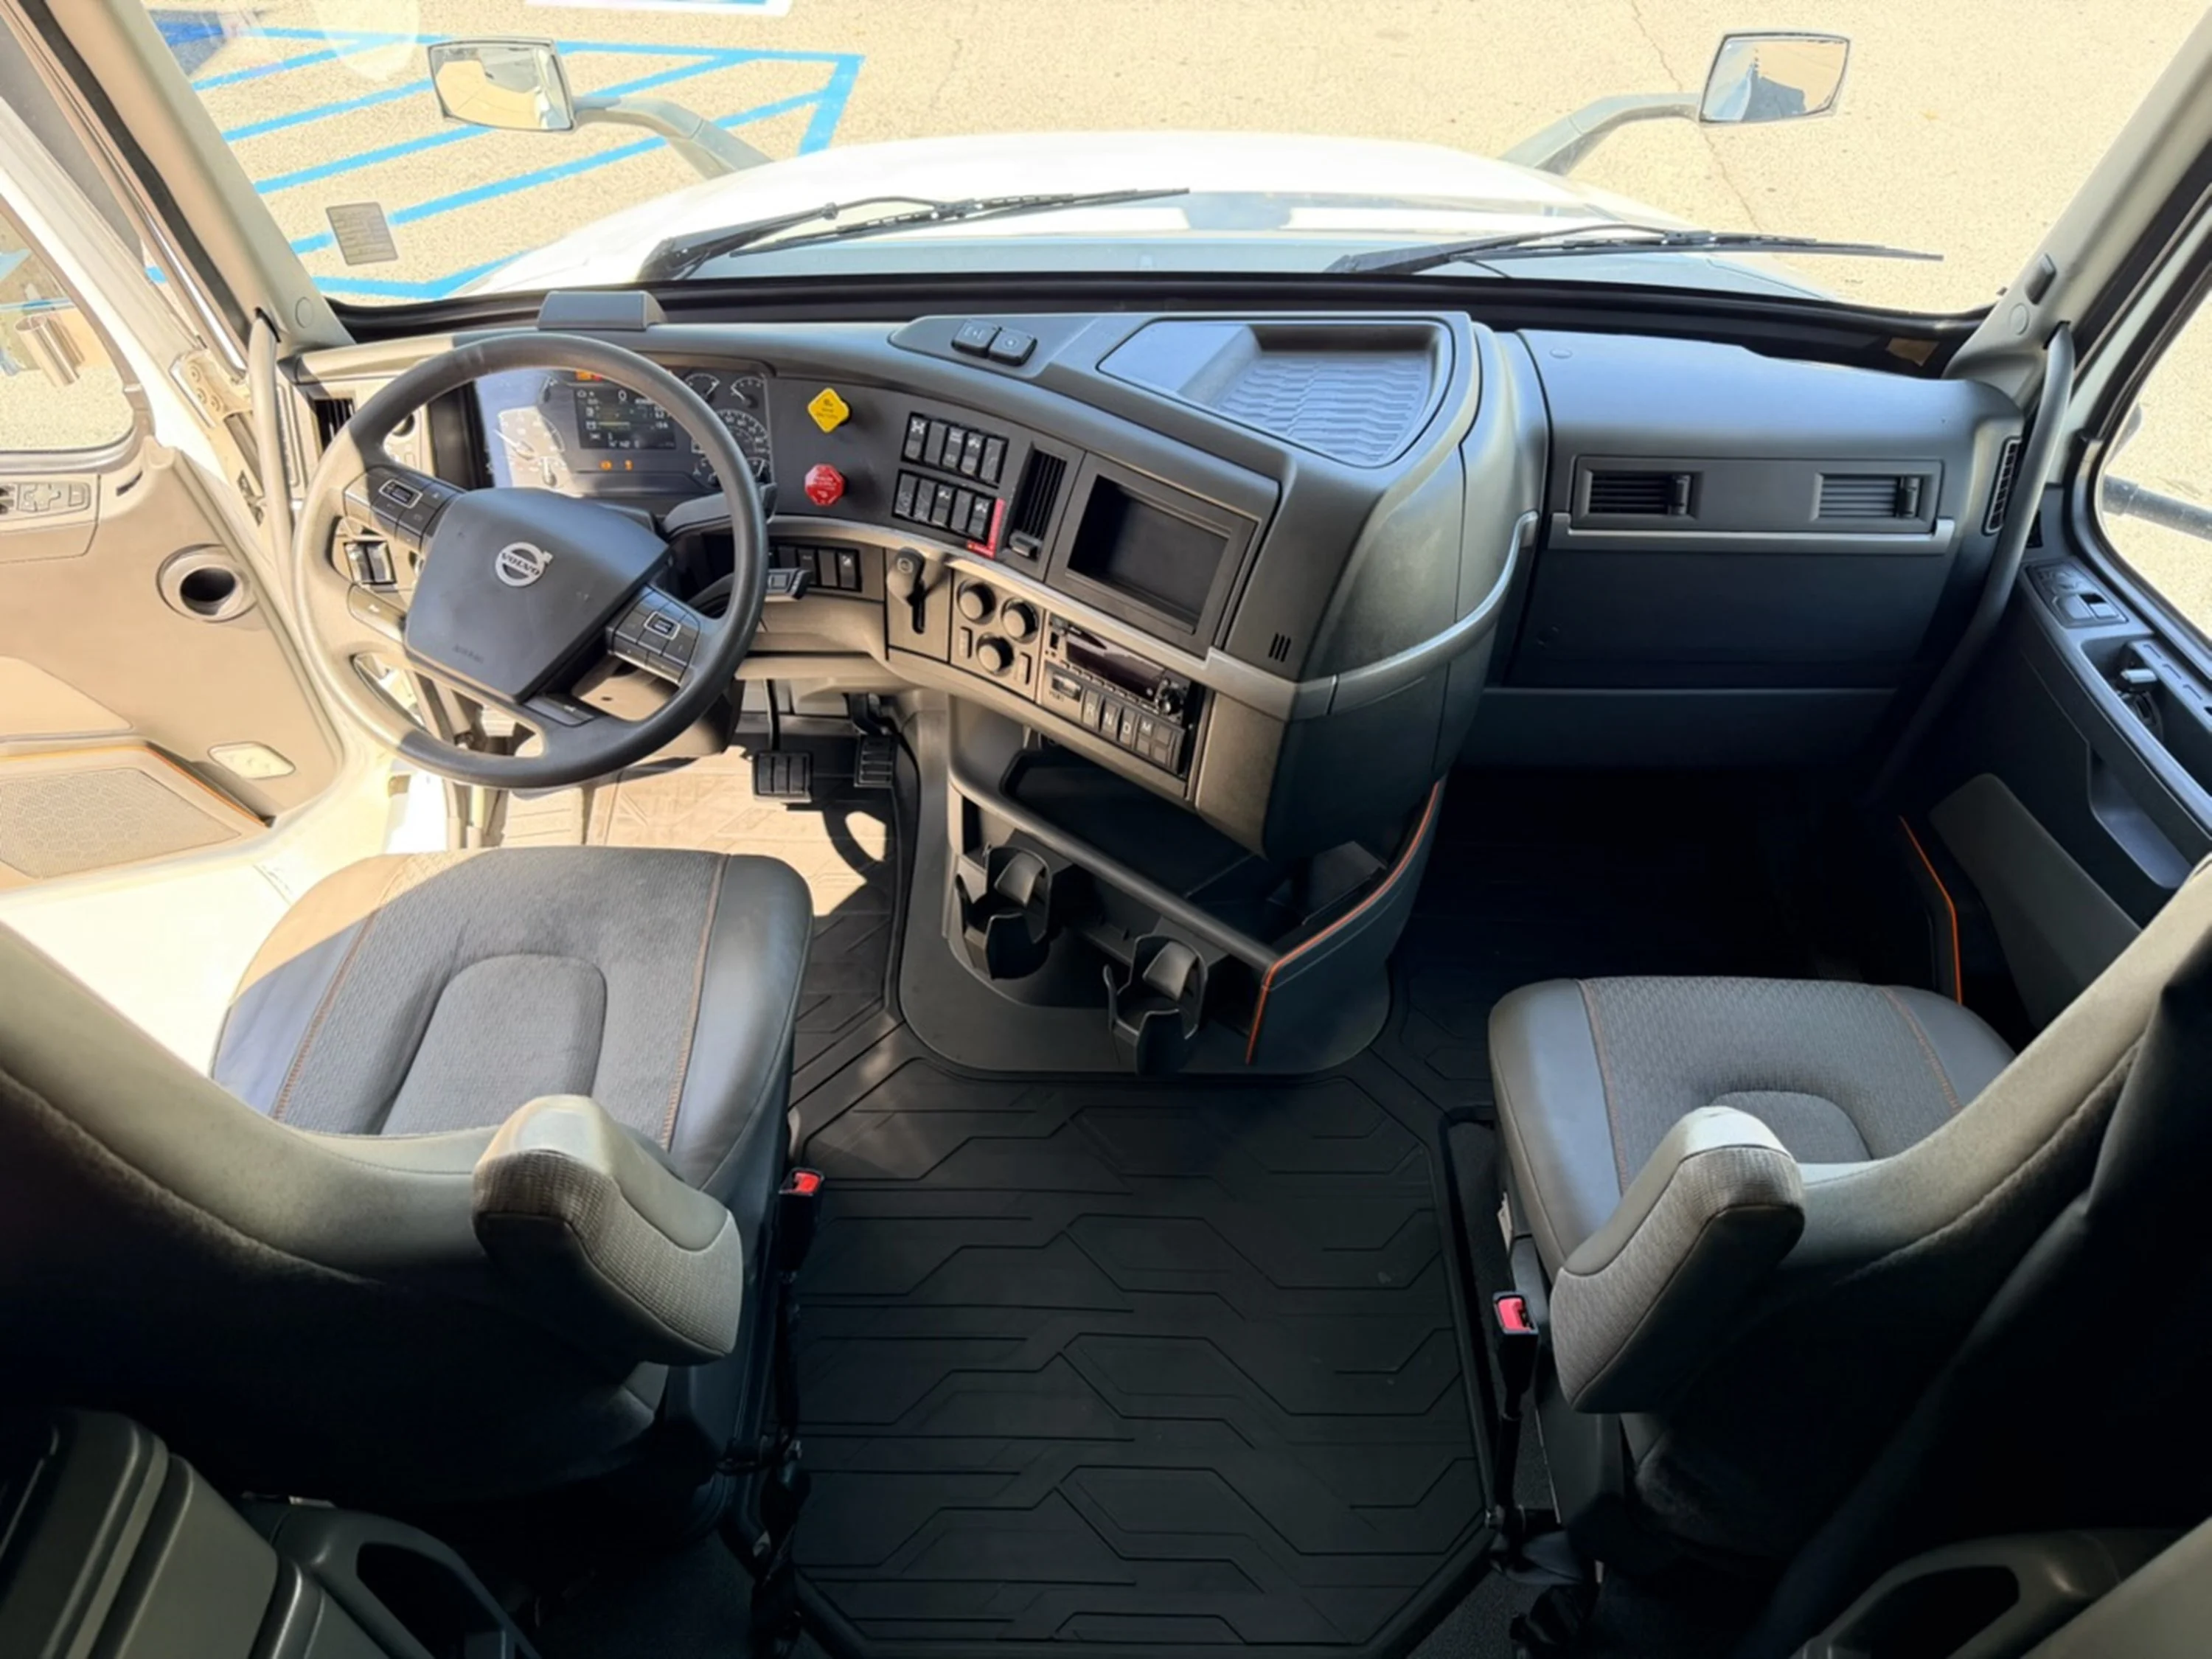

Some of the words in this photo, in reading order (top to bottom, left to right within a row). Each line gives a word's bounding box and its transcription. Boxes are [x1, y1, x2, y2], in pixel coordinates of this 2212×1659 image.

[501, 552, 540, 576] VOLVO
[1085, 703, 1095, 717] R
[1105, 712, 1113, 726] N
[1142, 721, 1152, 731] M
